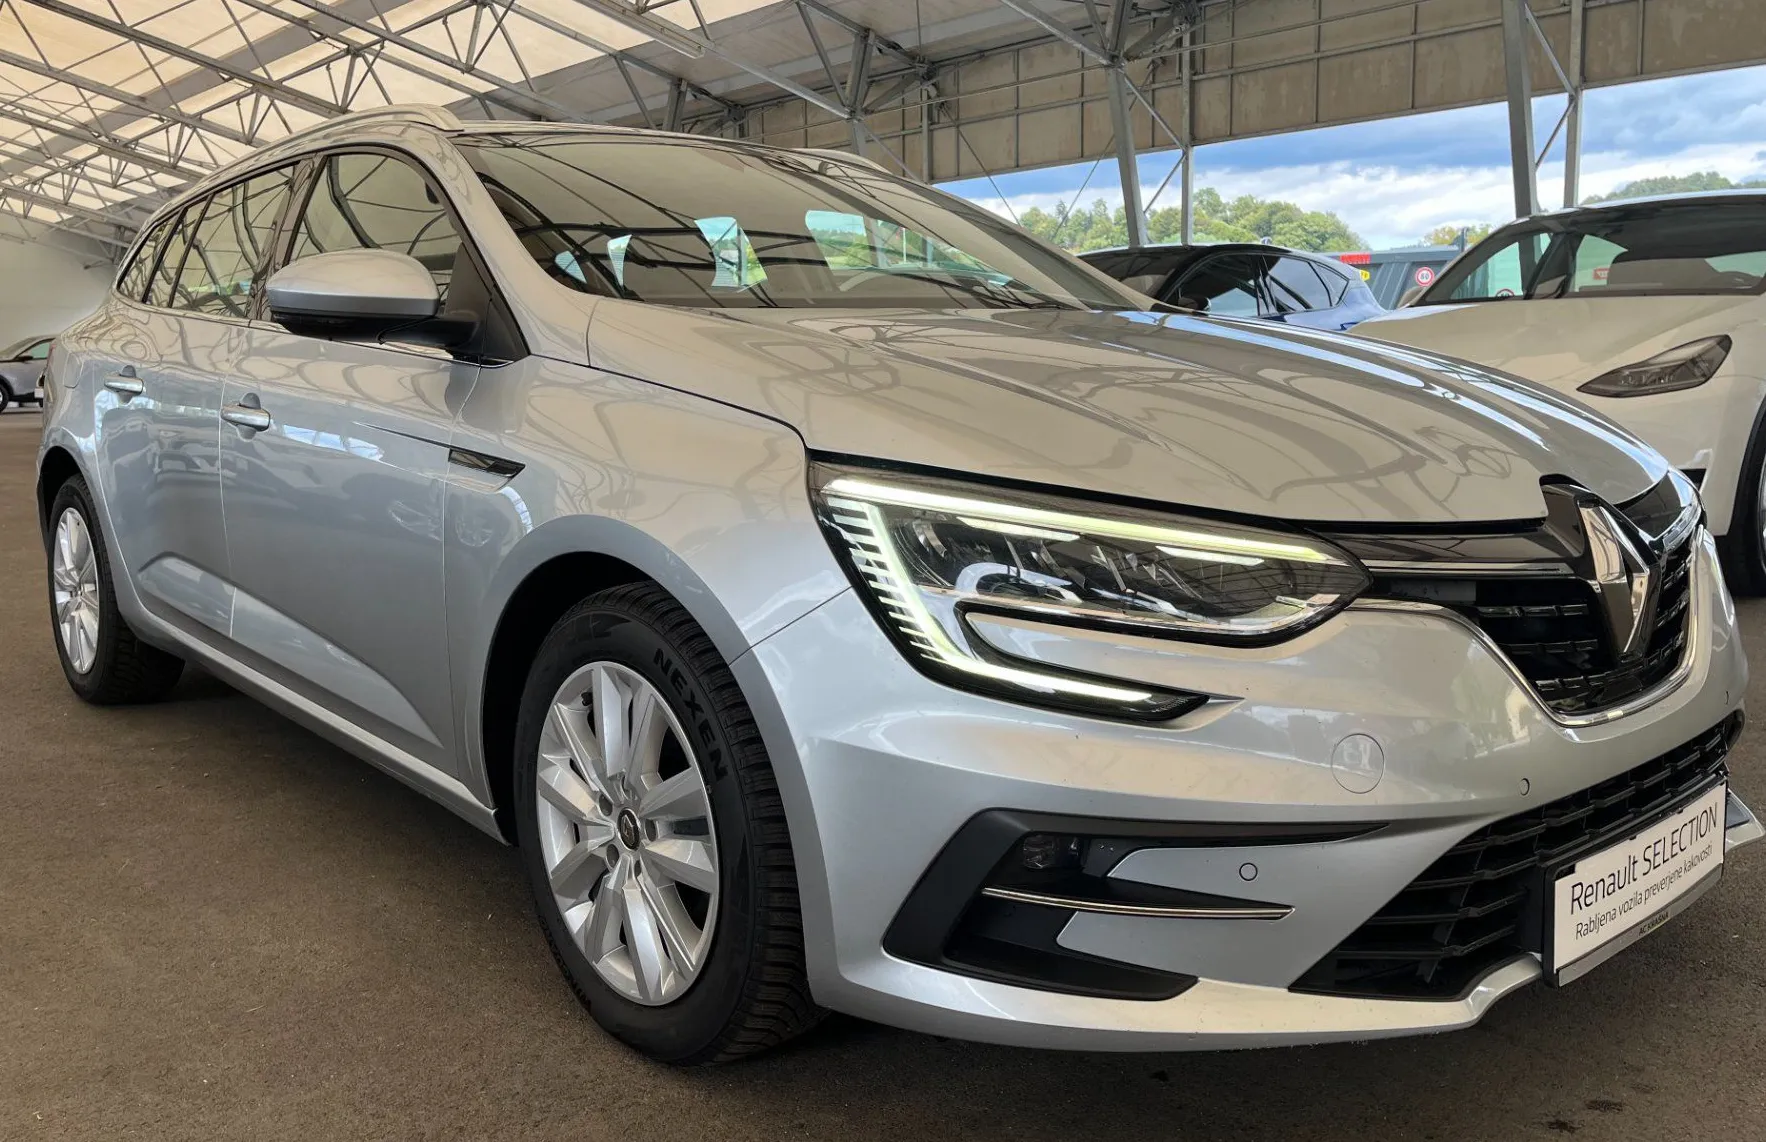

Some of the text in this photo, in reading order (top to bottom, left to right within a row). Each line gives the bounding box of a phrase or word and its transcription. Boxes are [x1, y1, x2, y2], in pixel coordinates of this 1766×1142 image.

[653, 647, 728, 782] NEXEN
[1570, 802, 1719, 915] Renault SELECTION
[1575, 841, 1713, 941] Rabljena vozila preverjene kakovosti
